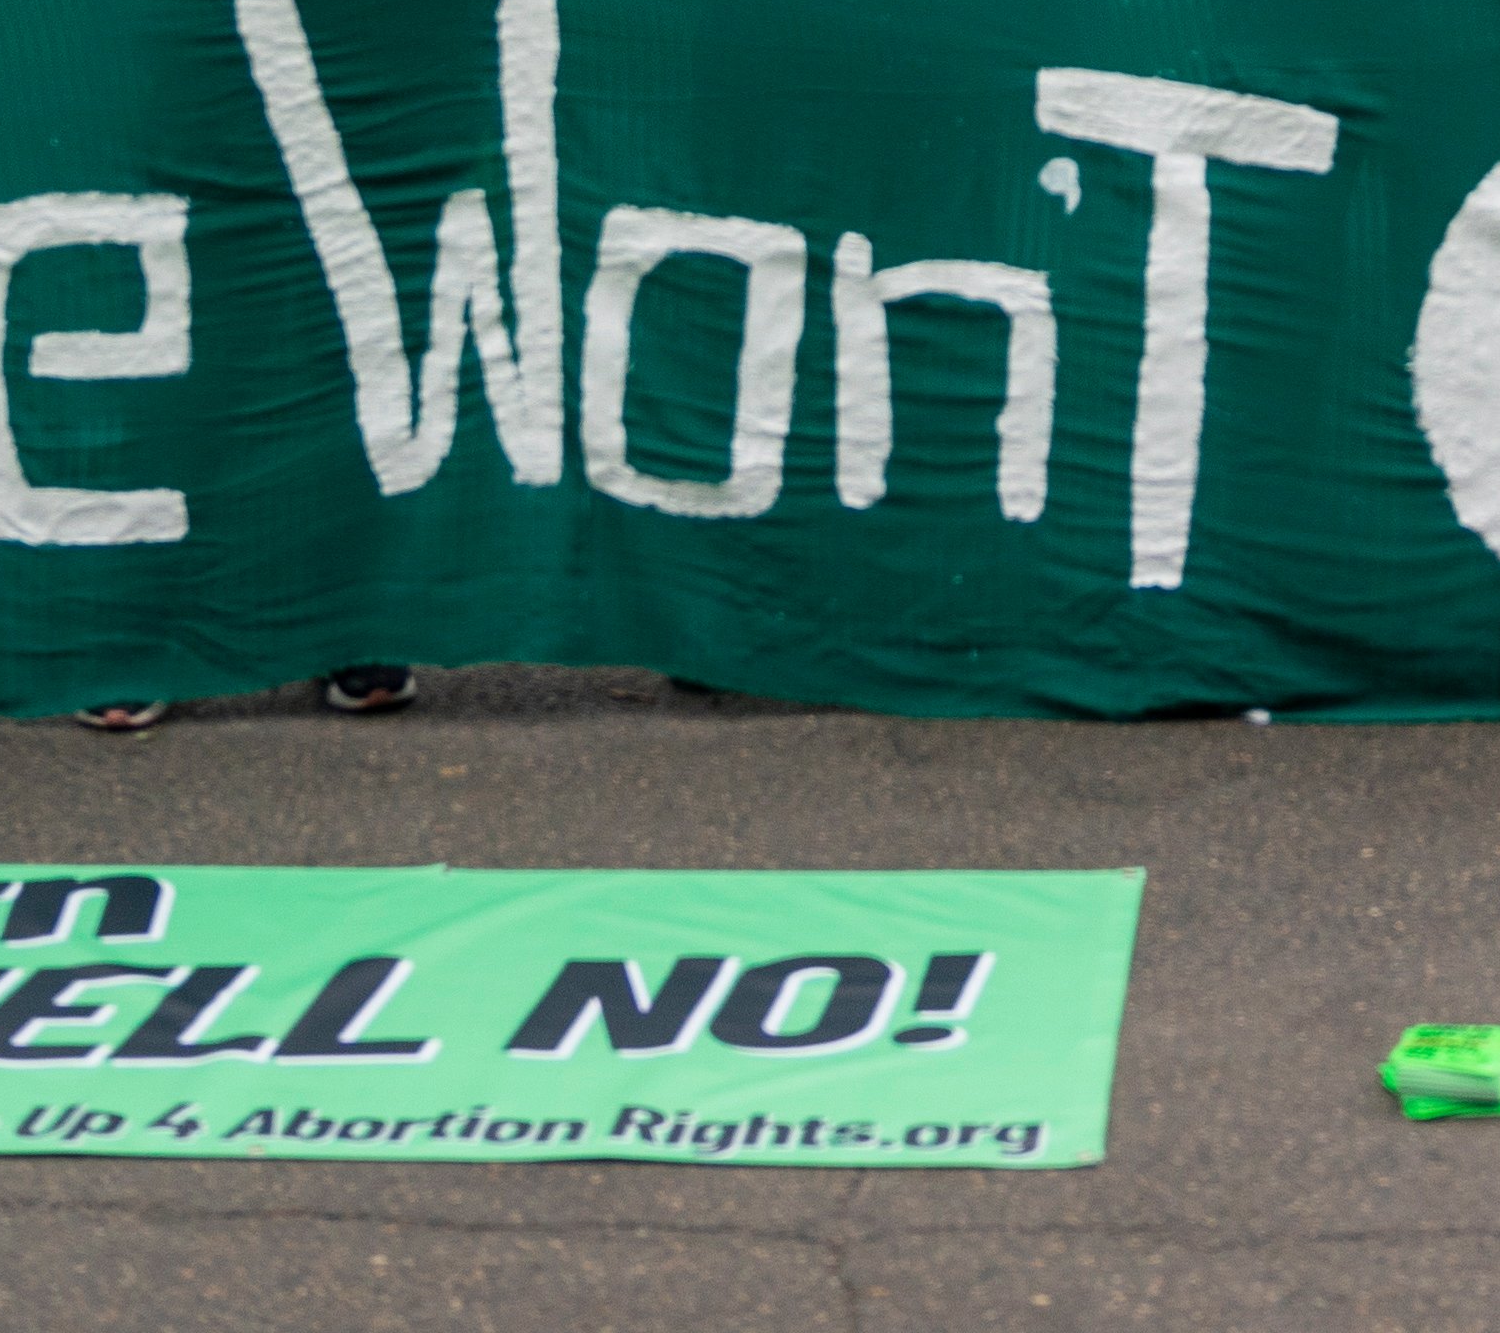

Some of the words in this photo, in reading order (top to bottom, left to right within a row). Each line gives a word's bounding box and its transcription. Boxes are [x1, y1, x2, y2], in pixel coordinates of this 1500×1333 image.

[504, 951, 996, 1061] NO!
[13, 1101, 127, 1147] Up
[158, 1102, 208, 1146] 4
[223, 1105, 591, 1150] Abortion
[610, 1102, 1051, 1159] Rights.org
